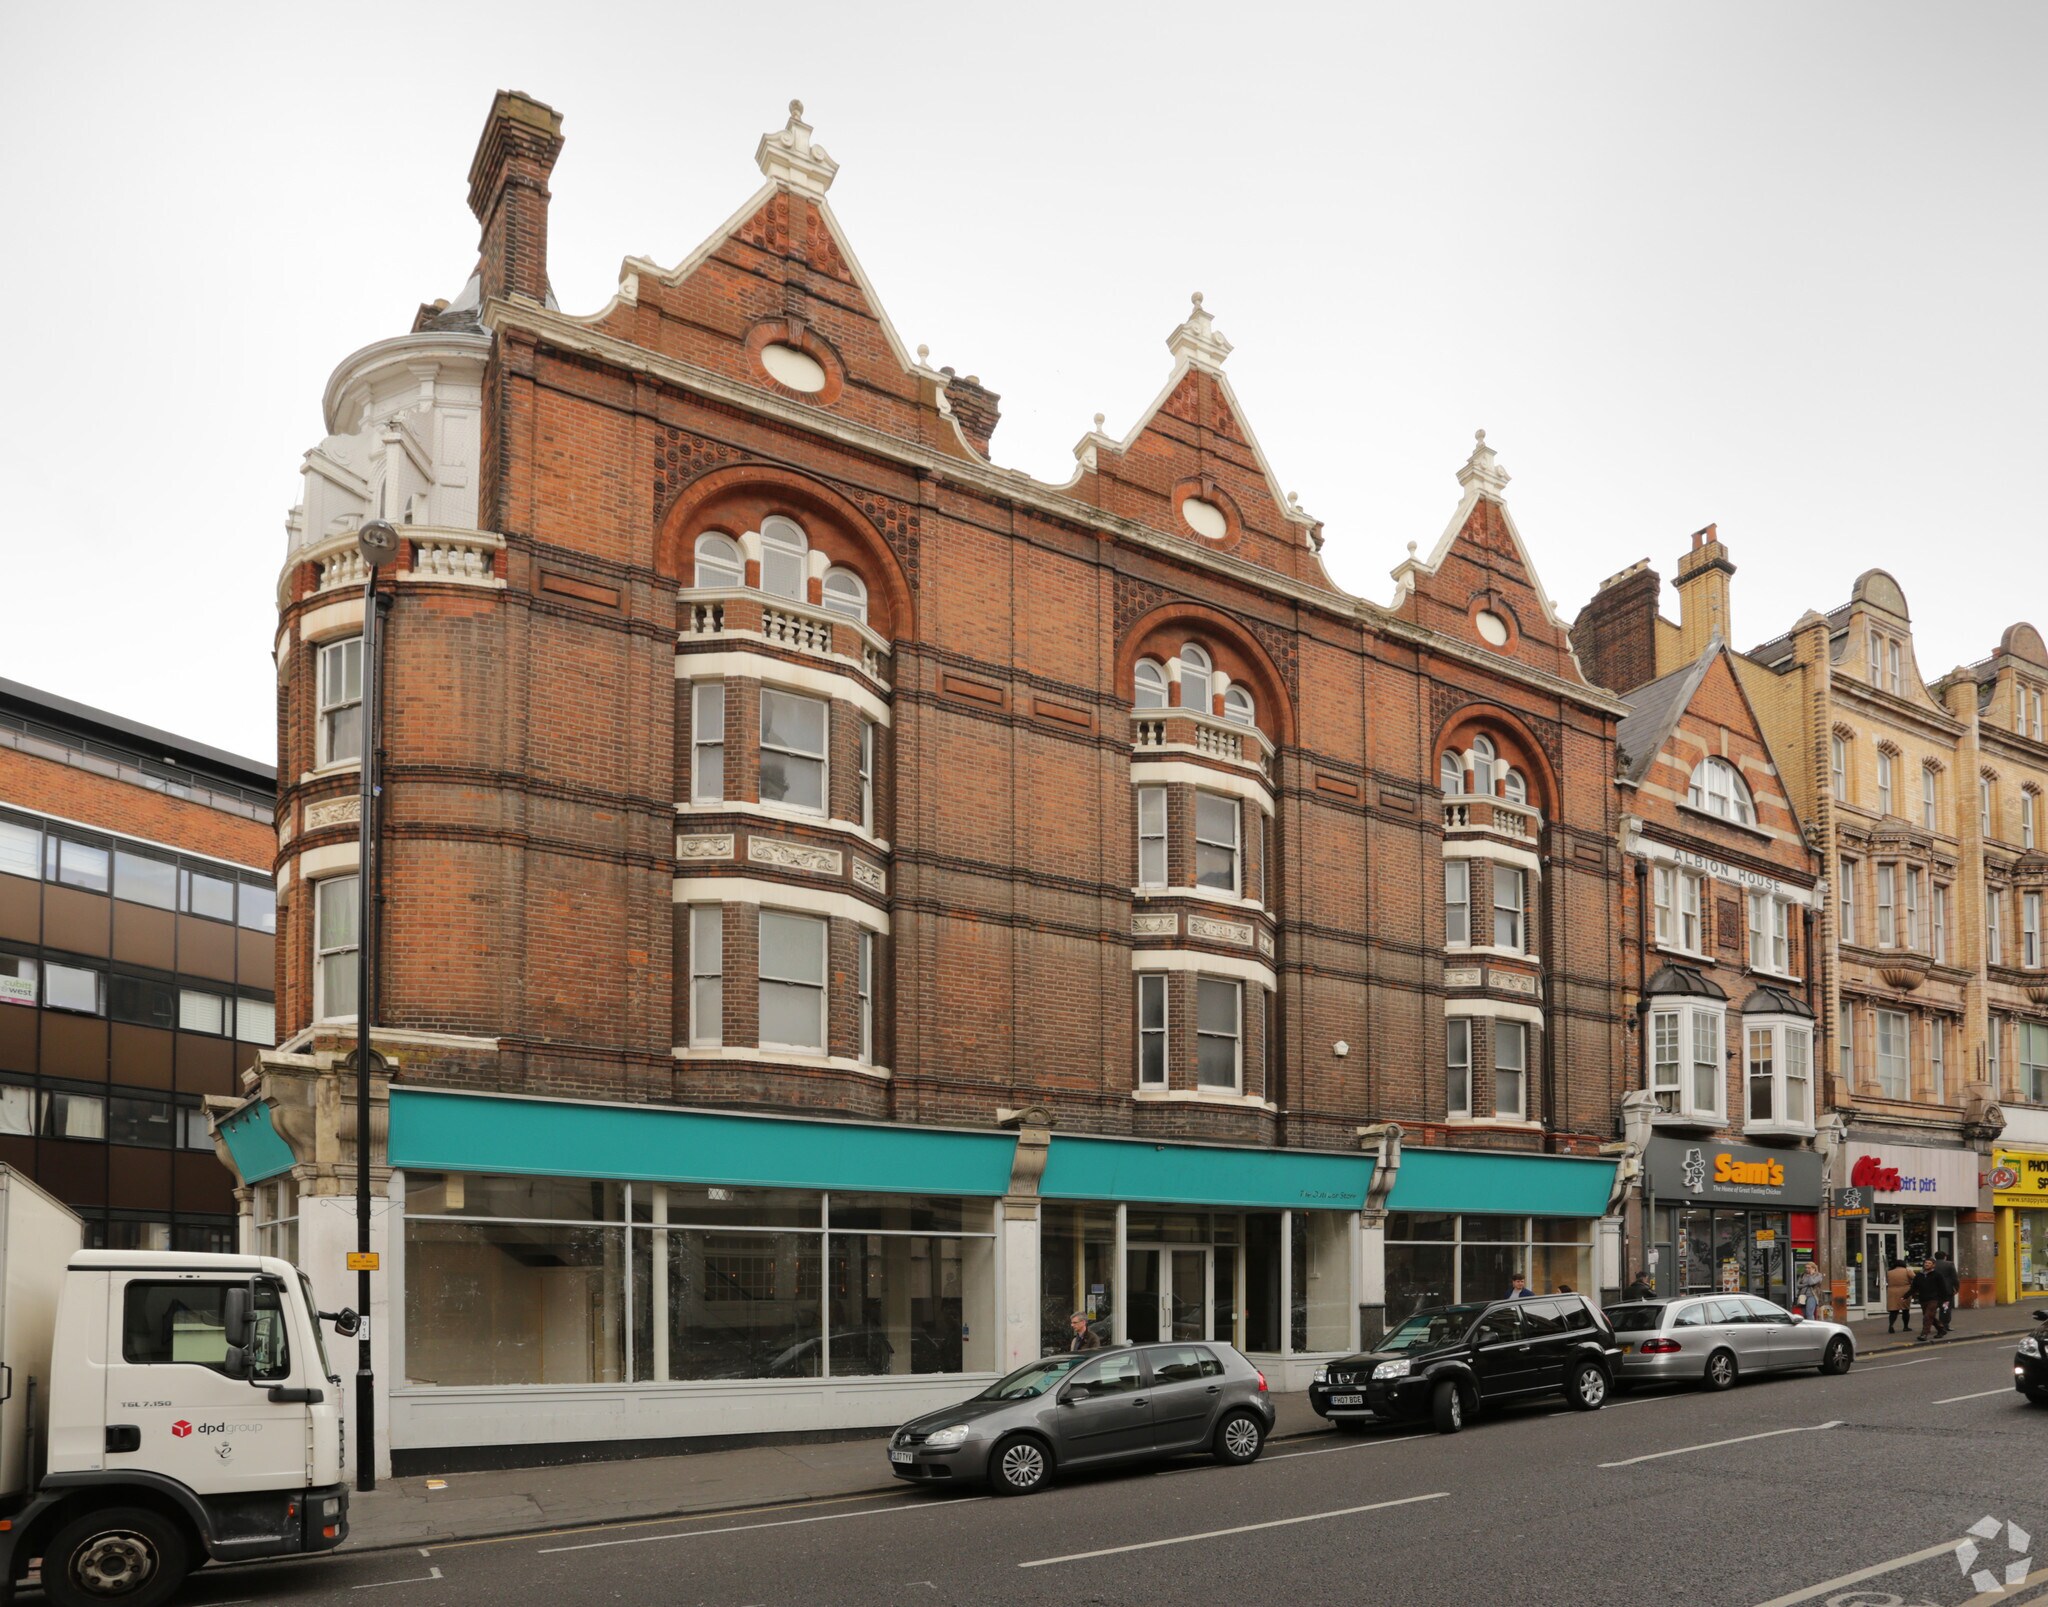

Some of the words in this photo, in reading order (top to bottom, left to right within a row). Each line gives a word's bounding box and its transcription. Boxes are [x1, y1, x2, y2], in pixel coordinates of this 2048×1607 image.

[1673, 849, 1729, 877] ALBION
[1713, 1153, 1784, 1187] Sam's
[1919, 1177, 1937, 1193] piri
[1837, 1206, 1870, 1217] Sam's
